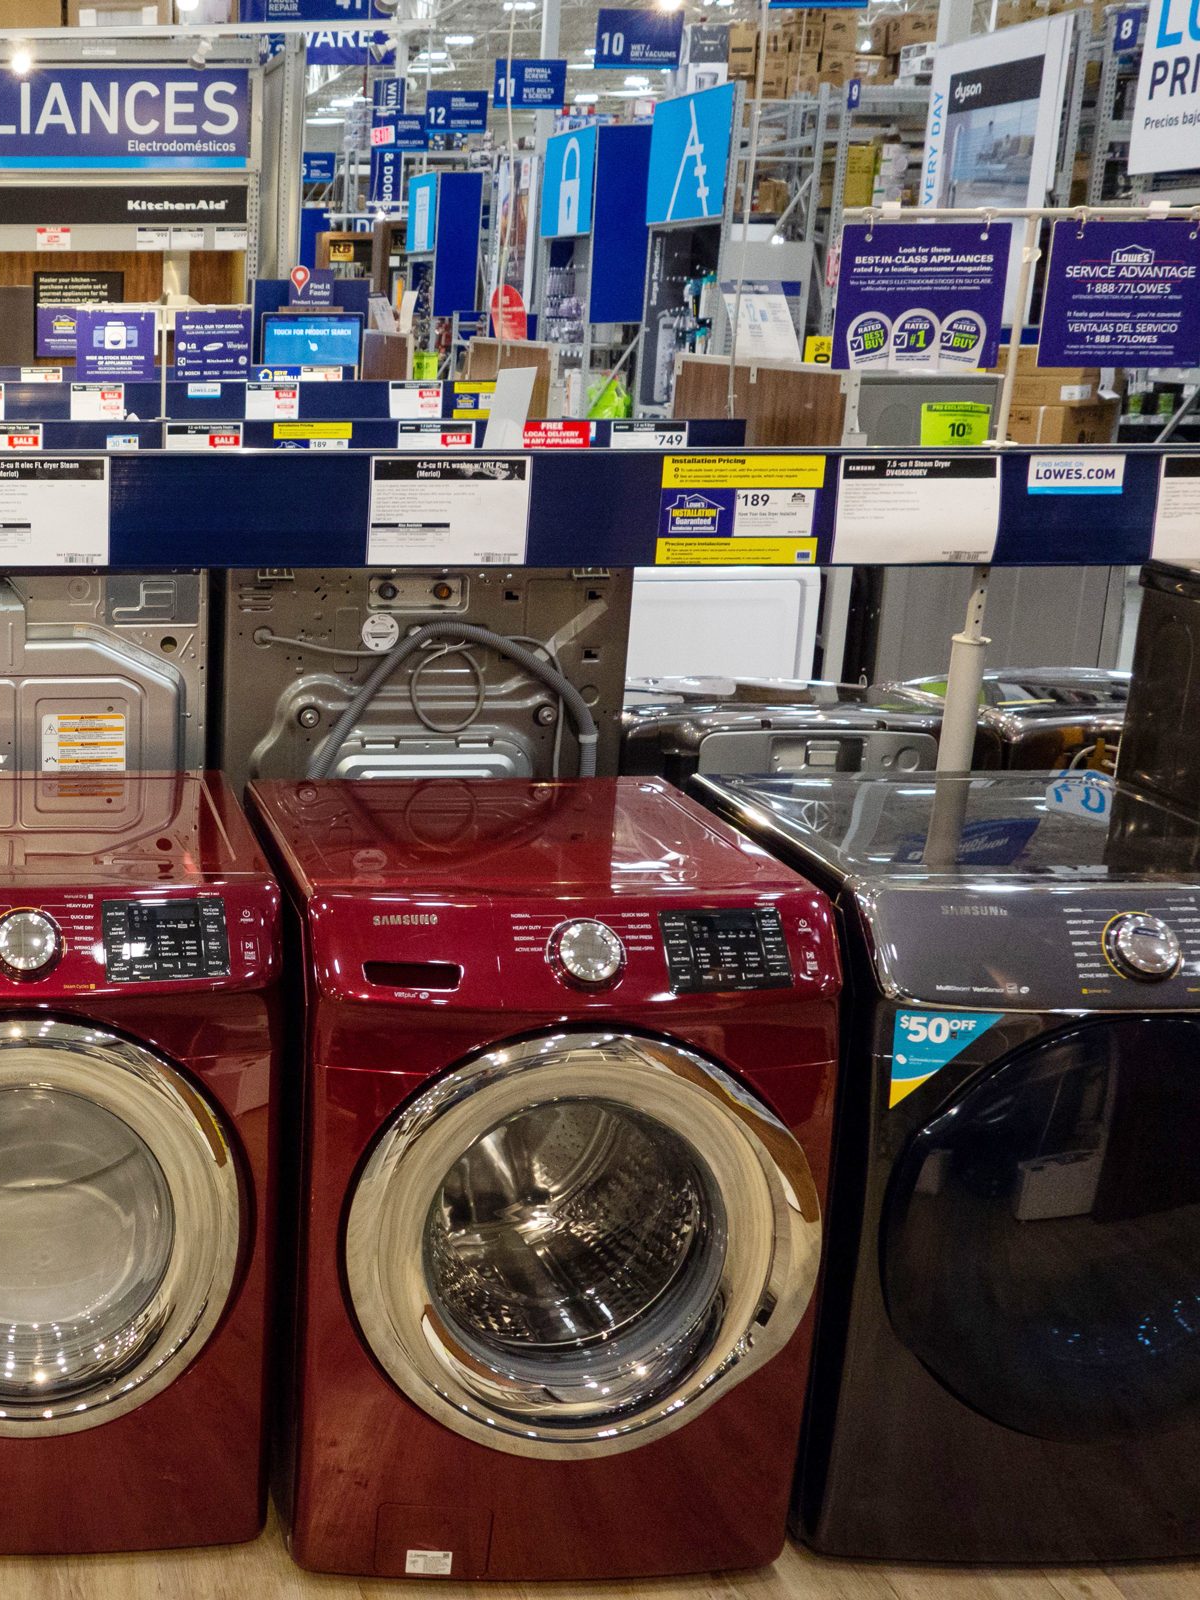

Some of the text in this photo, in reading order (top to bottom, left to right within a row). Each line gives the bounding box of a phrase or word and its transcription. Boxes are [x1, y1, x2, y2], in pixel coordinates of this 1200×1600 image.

[269, 3, 298, 11] REPAIR
[1120, 18, 1133, 40] 8
[601, 32, 624, 56] 10
[630, 50, 643, 58] DRY
[498, 78, 515, 98] 11
[852, 84, 859, 101] 9
[955, 80, 982, 104] dyson
[429, 107, 446, 124] 12
[931, 92, 944, 136] DAY
[1143, 113, 1179, 130] Precios
[127, 140, 236, 152] Electrodomésticos
[383, 152, 394, 162] &
[127, 200, 226, 211] KitchenAid
[332, 243, 352, 254] RB
[855, 254, 994, 264] BEST-IN-CLASS APPLIANCES
[891, 265, 918, 273] leading
[956, 265, 993, 273] magazine.
[1065, 265, 1196, 278] SERVICE ADVANTAGE
[309, 289, 330, 297] Faster
[273, 328, 292, 336] TOUCH
[857, 323, 882, 334] RATED
[904, 323, 930, 331] RATED
[952, 323, 977, 333] RATED
[1068, 323, 1179, 333] VENTAJAS DEL SERVICIO
[864, 329, 884, 341] BEST
[909, 330, 926, 347] #1
[864, 338, 885, 351] BUY
[952, 337, 975, 349] BUY
[541, 422, 564, 430] FREE
[13, 437, 33, 445] SALE
[446, 434, 467, 443] SALE
[43, 461, 59, 470] dryer
[60, 461, 79, 469] Steam
[417, 461, 436, 469] 4.5-cu
[416, 469, 441, 479] (Merlot)
[1035, 468, 1116, 480] LOWES.COM
[940, 905, 1008, 917] SAMSUNG
[373, 914, 438, 926] SAMSUNG
[899, 1014, 977, 1043] $50 OFF
